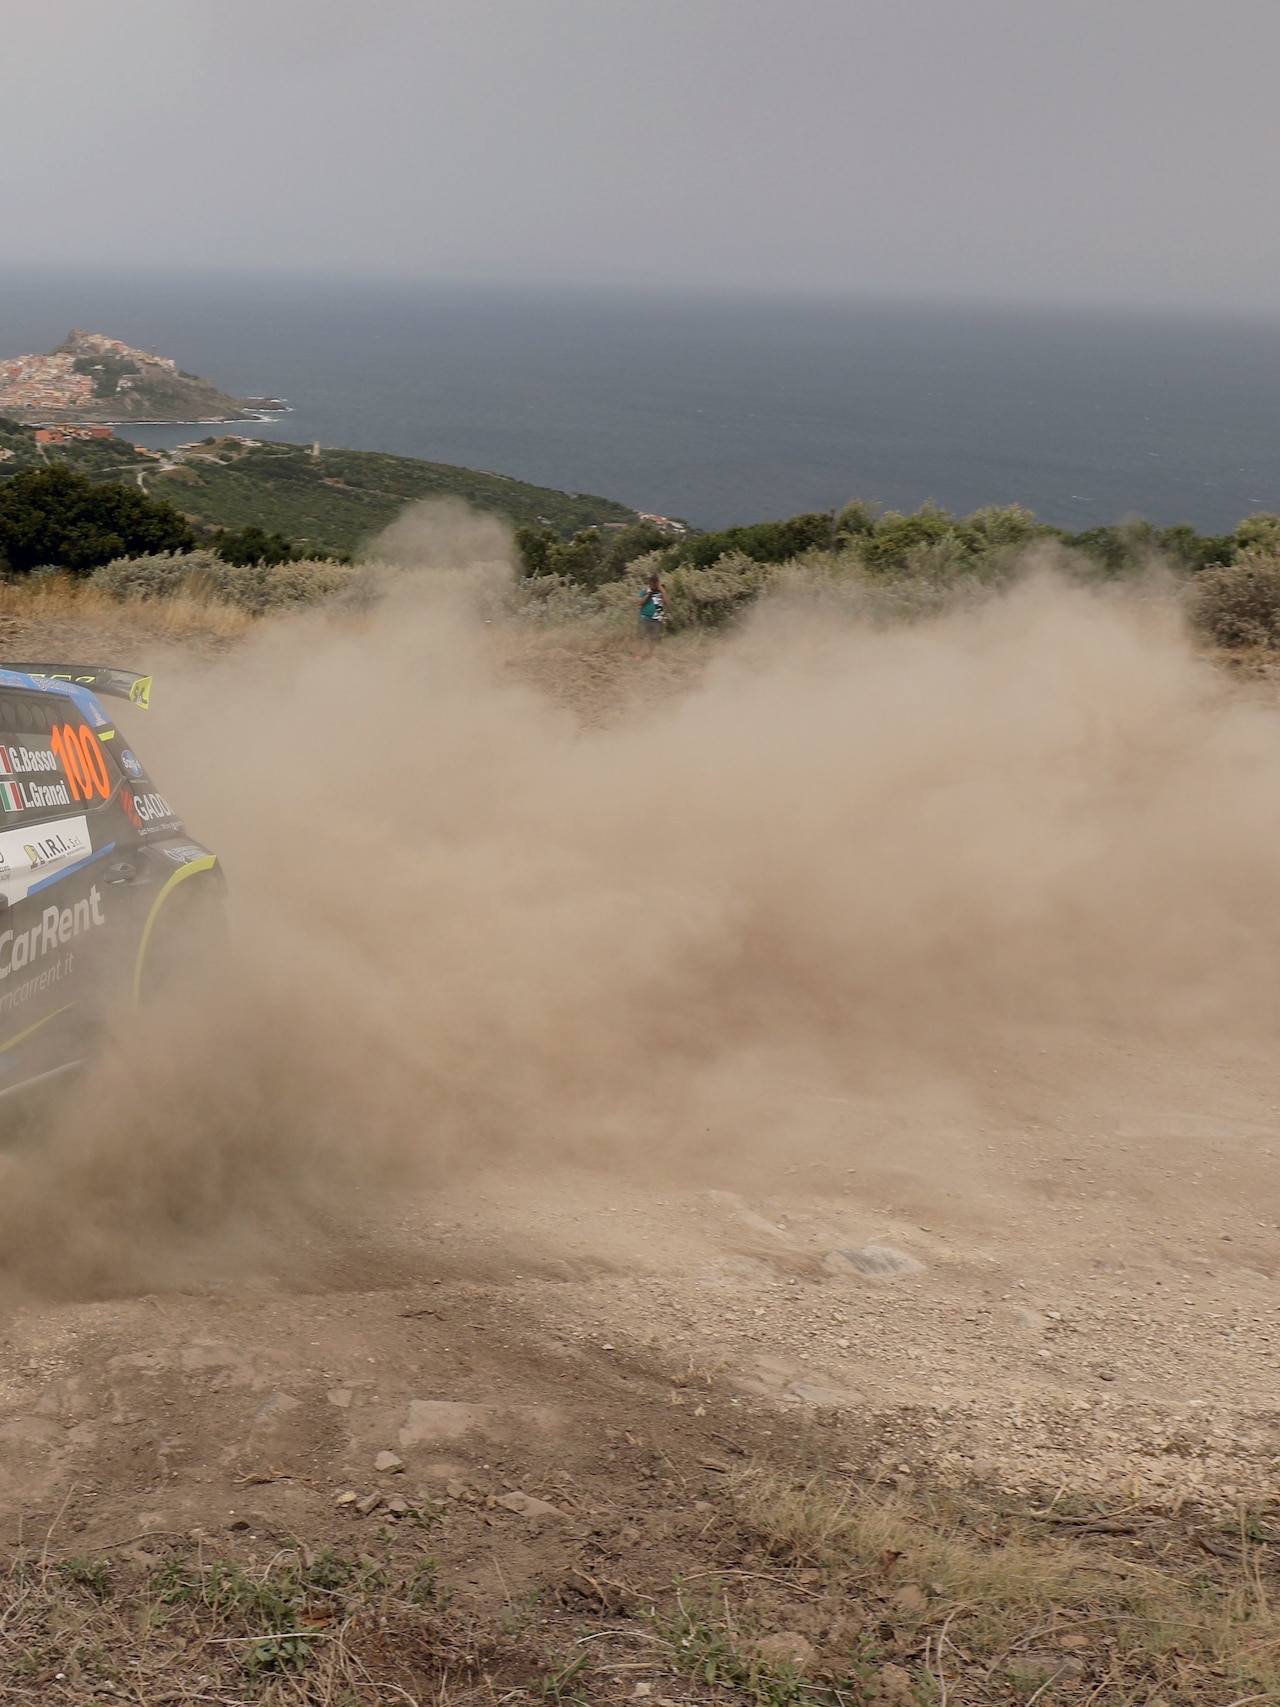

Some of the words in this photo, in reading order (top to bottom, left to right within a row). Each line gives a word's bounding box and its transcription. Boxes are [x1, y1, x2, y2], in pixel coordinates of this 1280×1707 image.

[8, 746, 58, 774] G.Basso
[50, 723, 111, 801] 100
[19, 779, 70, 809] L.Granai
